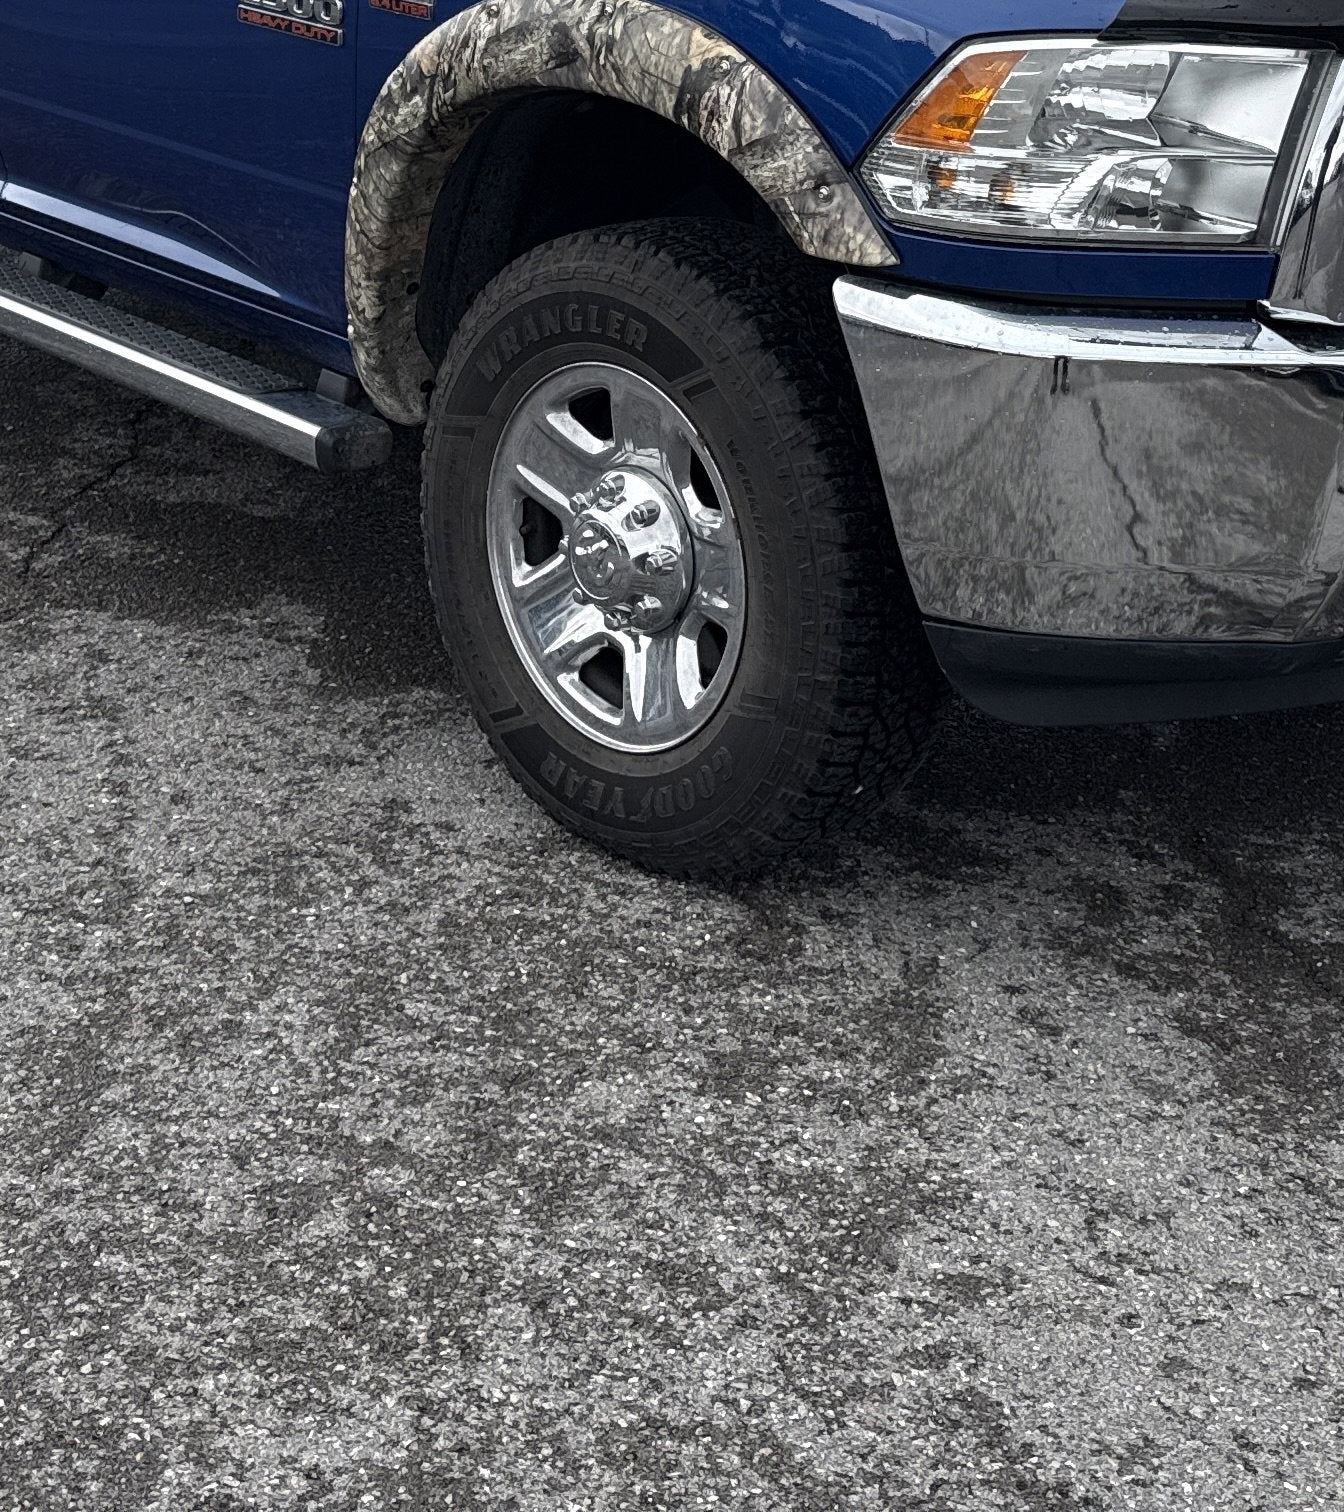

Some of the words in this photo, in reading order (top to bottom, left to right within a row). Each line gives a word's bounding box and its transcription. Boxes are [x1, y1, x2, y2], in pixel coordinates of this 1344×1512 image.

[239, 8, 290, 30] HEAVY
[291, 22, 336, 41] DUTY
[391, 0, 429, 17] LITER
[476, 303, 648, 382] WRANGLER
[540, 746, 733, 823] GOODYEAR
